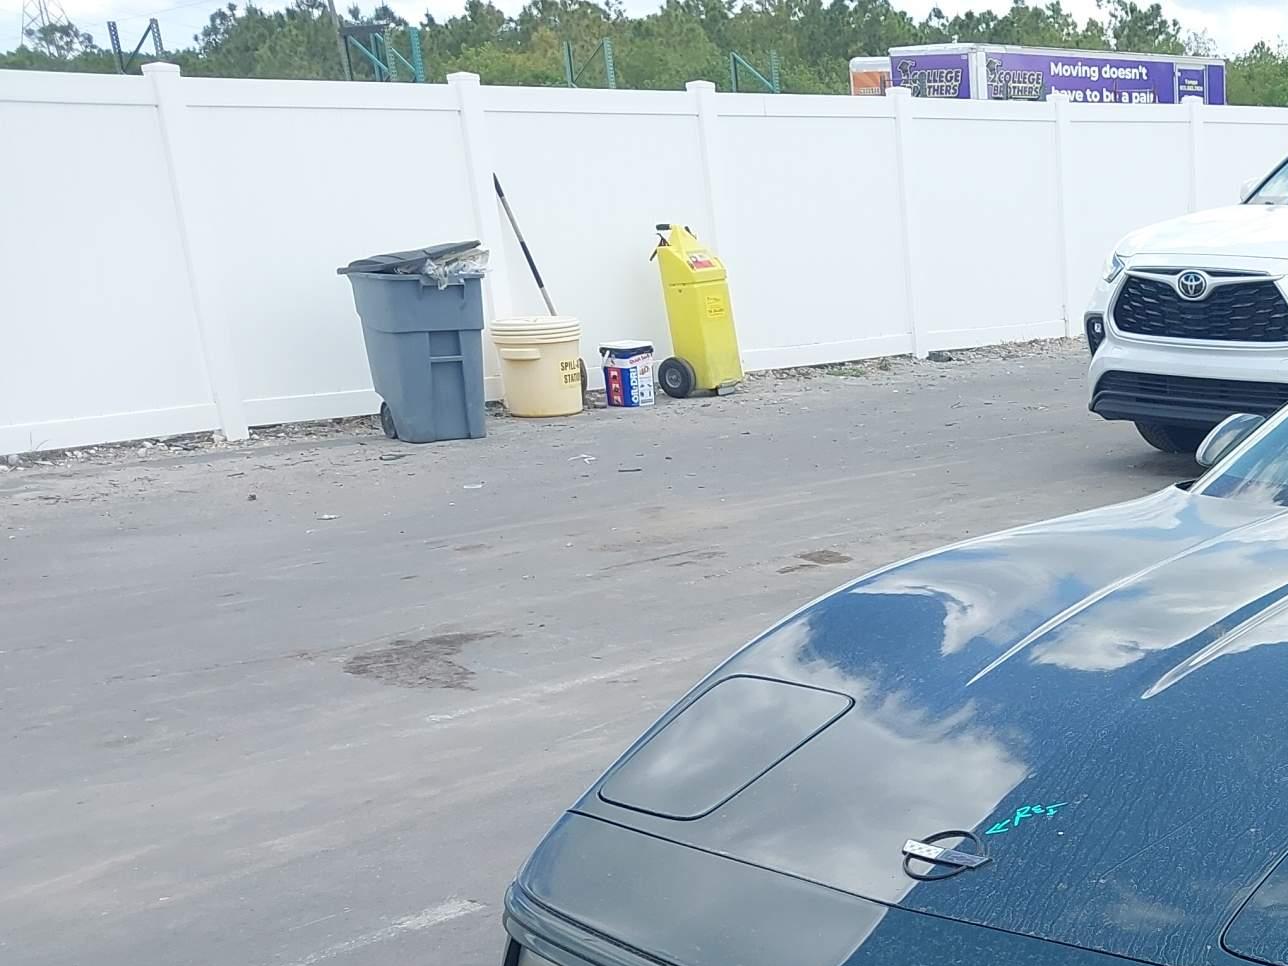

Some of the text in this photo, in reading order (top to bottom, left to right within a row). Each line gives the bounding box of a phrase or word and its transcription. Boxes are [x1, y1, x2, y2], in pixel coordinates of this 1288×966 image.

[911, 71, 960, 84] CLLEGE
[1050, 61, 1148, 81] Moving doesn't
[1085, 88, 1100, 102] to
[1121, 91, 1130, 103] a
